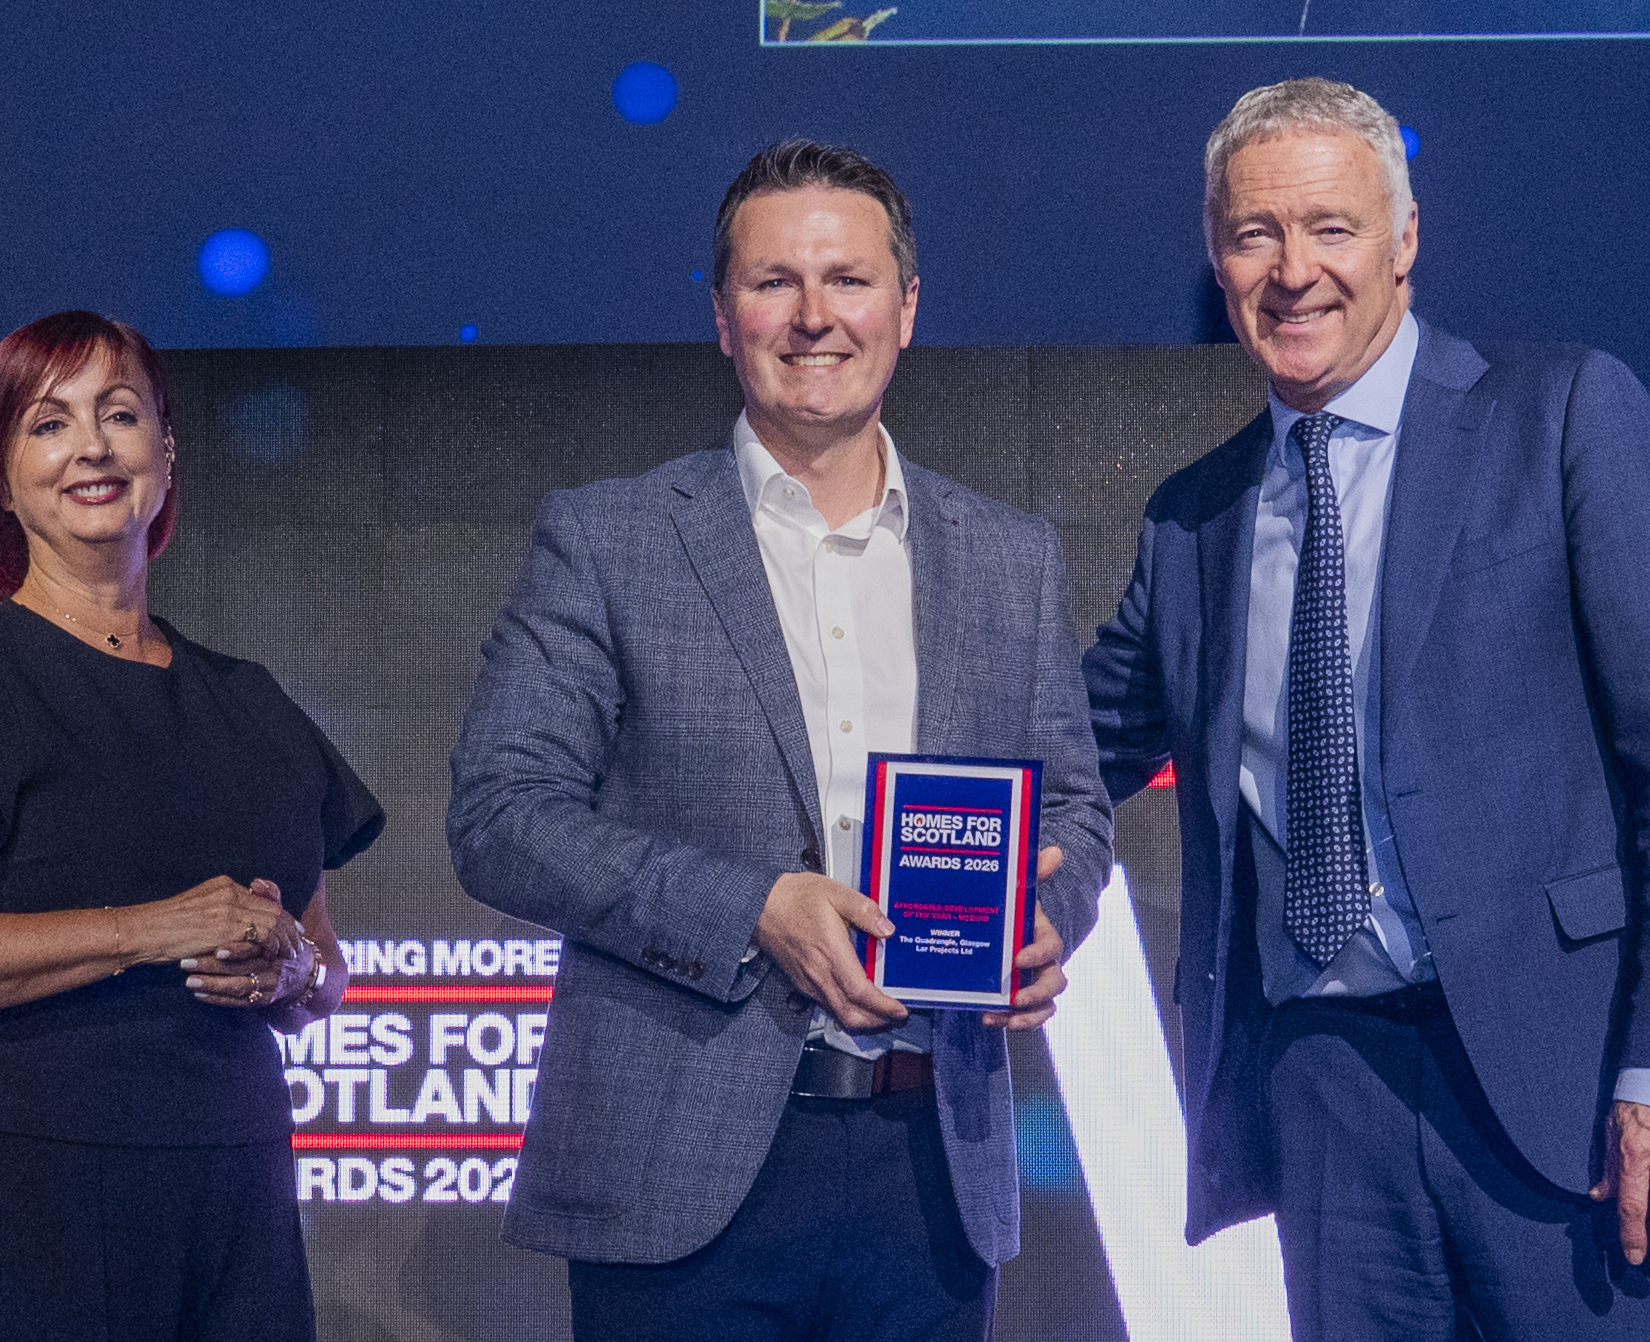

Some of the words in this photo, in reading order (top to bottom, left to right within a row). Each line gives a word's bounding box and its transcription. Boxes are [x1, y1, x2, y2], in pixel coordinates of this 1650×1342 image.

[901, 813, 963, 829] HOMES
[967, 816, 1002, 831] FOR
[901, 827, 1001, 846] SCOTLAND
[899, 855, 961, 870] AWARDS
[964, 859, 999, 872] 2026
[899, 935, 913, 943] The
[960, 939, 990, 948] Glasgow
[930, 929, 960, 937] WINNER
[433, 939, 562, 976] MORE
[929, 946, 959, 954] Projects
[960, 947, 973, 955] Ltd
[269, 1012, 413, 1066] MES
[296, 1157, 416, 1203] RDS
[422, 1157, 519, 1203] 202
